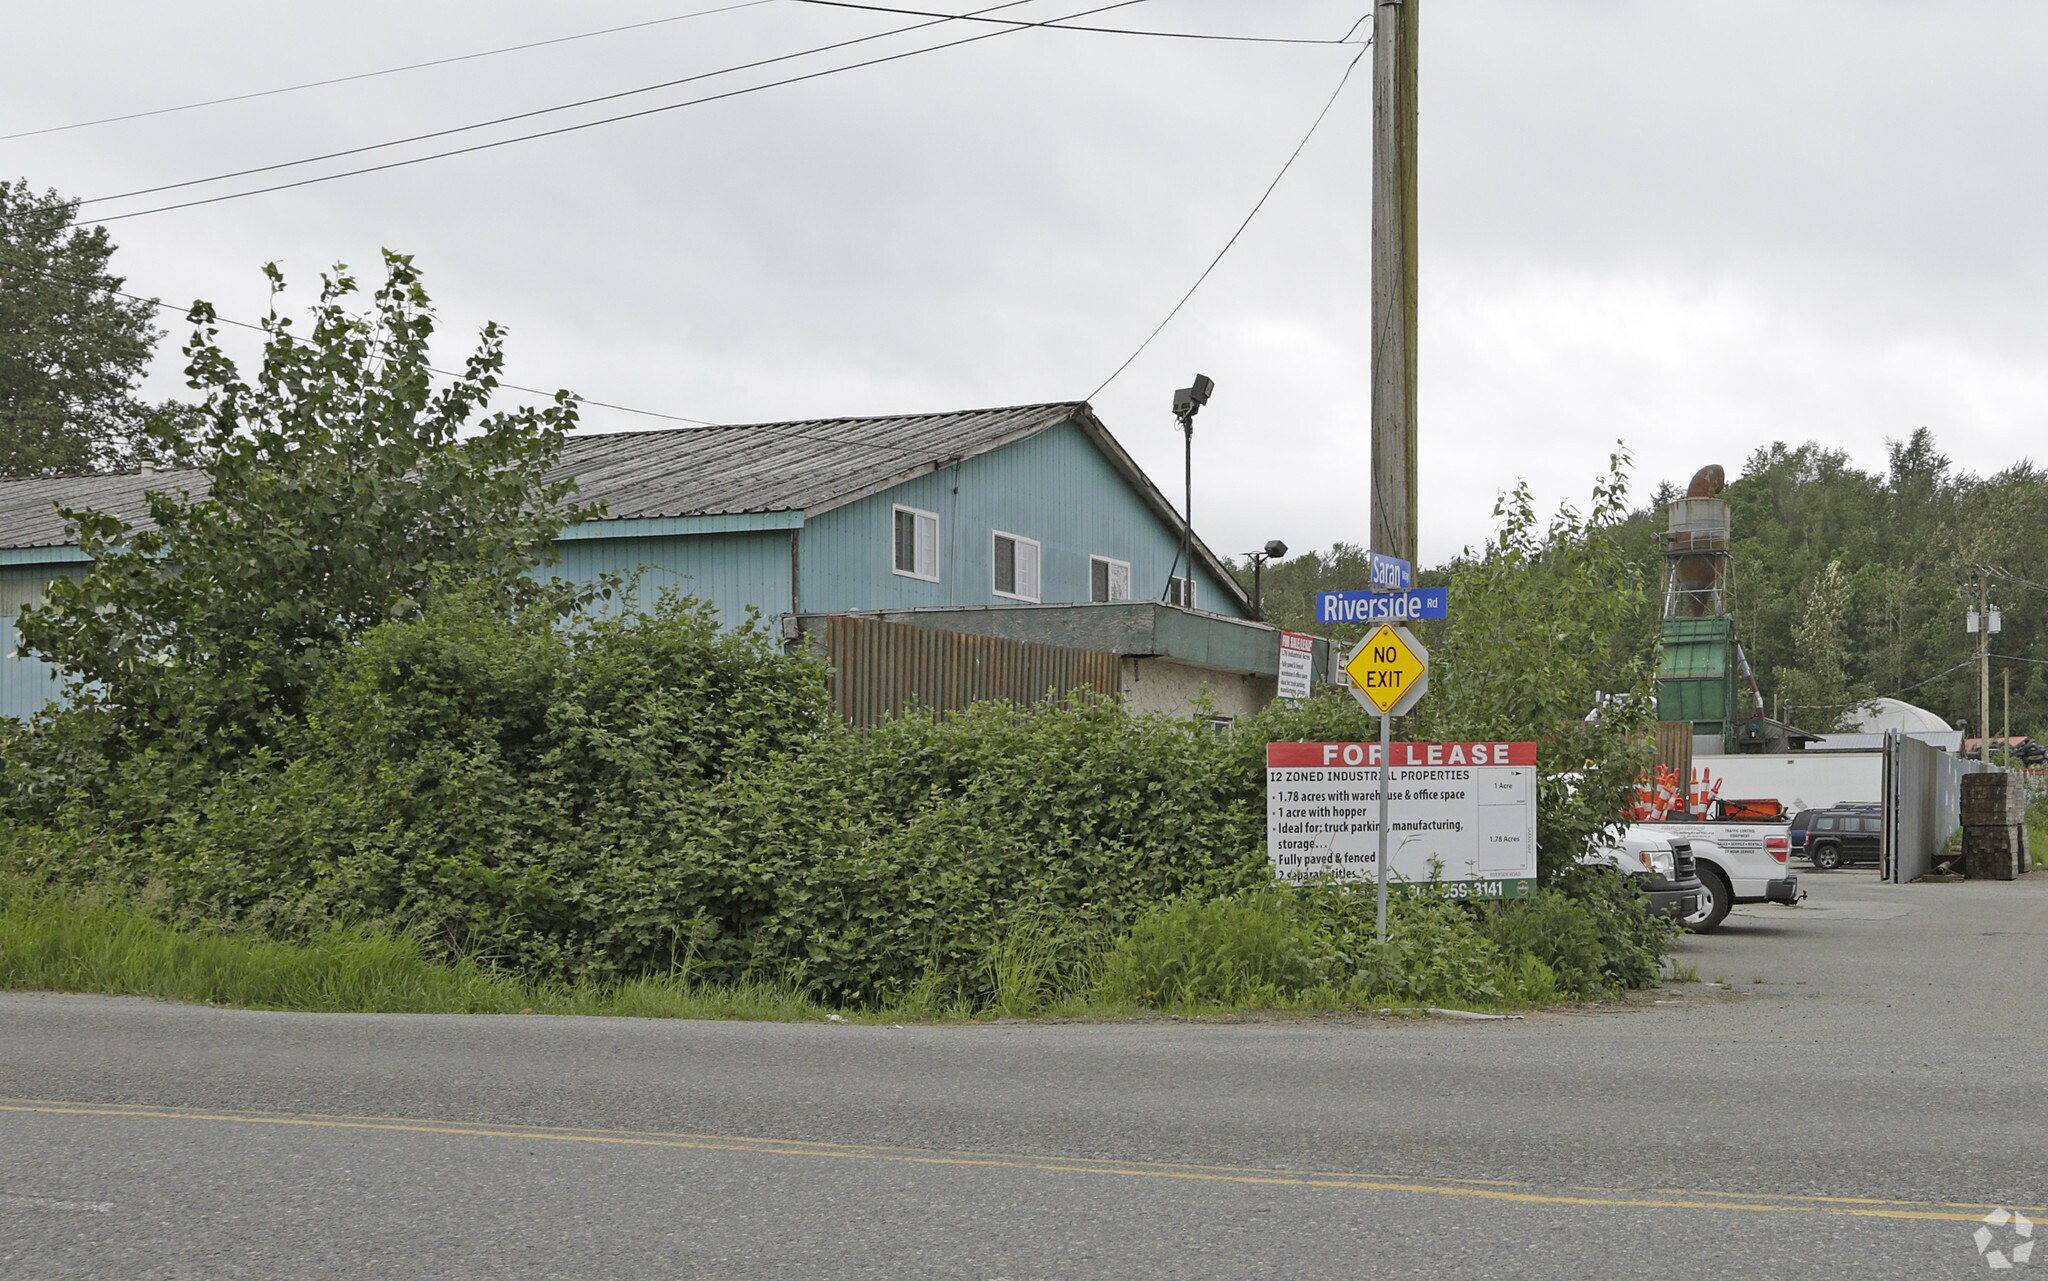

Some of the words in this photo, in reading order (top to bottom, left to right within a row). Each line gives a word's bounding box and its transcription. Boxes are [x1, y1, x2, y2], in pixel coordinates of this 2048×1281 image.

[1374, 556, 1400, 586] Saran
[1324, 593, 1422, 621] Riverside
[1427, 598, 1438, 608] Rd
[1374, 646, 1396, 663] NO
[1367, 671, 1403, 688] EXIT
[1323, 744, 1382, 765] FOR
[1406, 744, 1509, 765] LEASE
[1270, 772, 1282, 782] I2
[1286, 772, 1324, 782] ZONED
[1401, 770, 1470, 780] PROPERTIES
[1278, 792, 1299, 802] 1.78
[1328, 790, 1349, 801] with
[1352, 790, 1402, 801] warehuse
[1405, 790, 1412, 800] &
[1414, 789, 1438, 800] office
[1440, 790, 1465, 802] space
[1278, 807, 1283, 817] 1
[1286, 809, 1306, 817] acre
[1309, 806, 1330, 817] with
[1333, 806, 1367, 819] hopper
[1278, 822, 1303, 833] Ideal
[1305, 822, 1322, 833] for:
[1324, 821, 1349, 832] truck
[1351, 821, 1390, 834] parkin,
[1393, 819, 1463, 832] manufacturing,
[1278, 854, 1302, 867] Fully
[1304, 853, 1332, 867] paved
[1336, 853, 1342, 863] &
[1344, 852, 1375, 862] fenced
